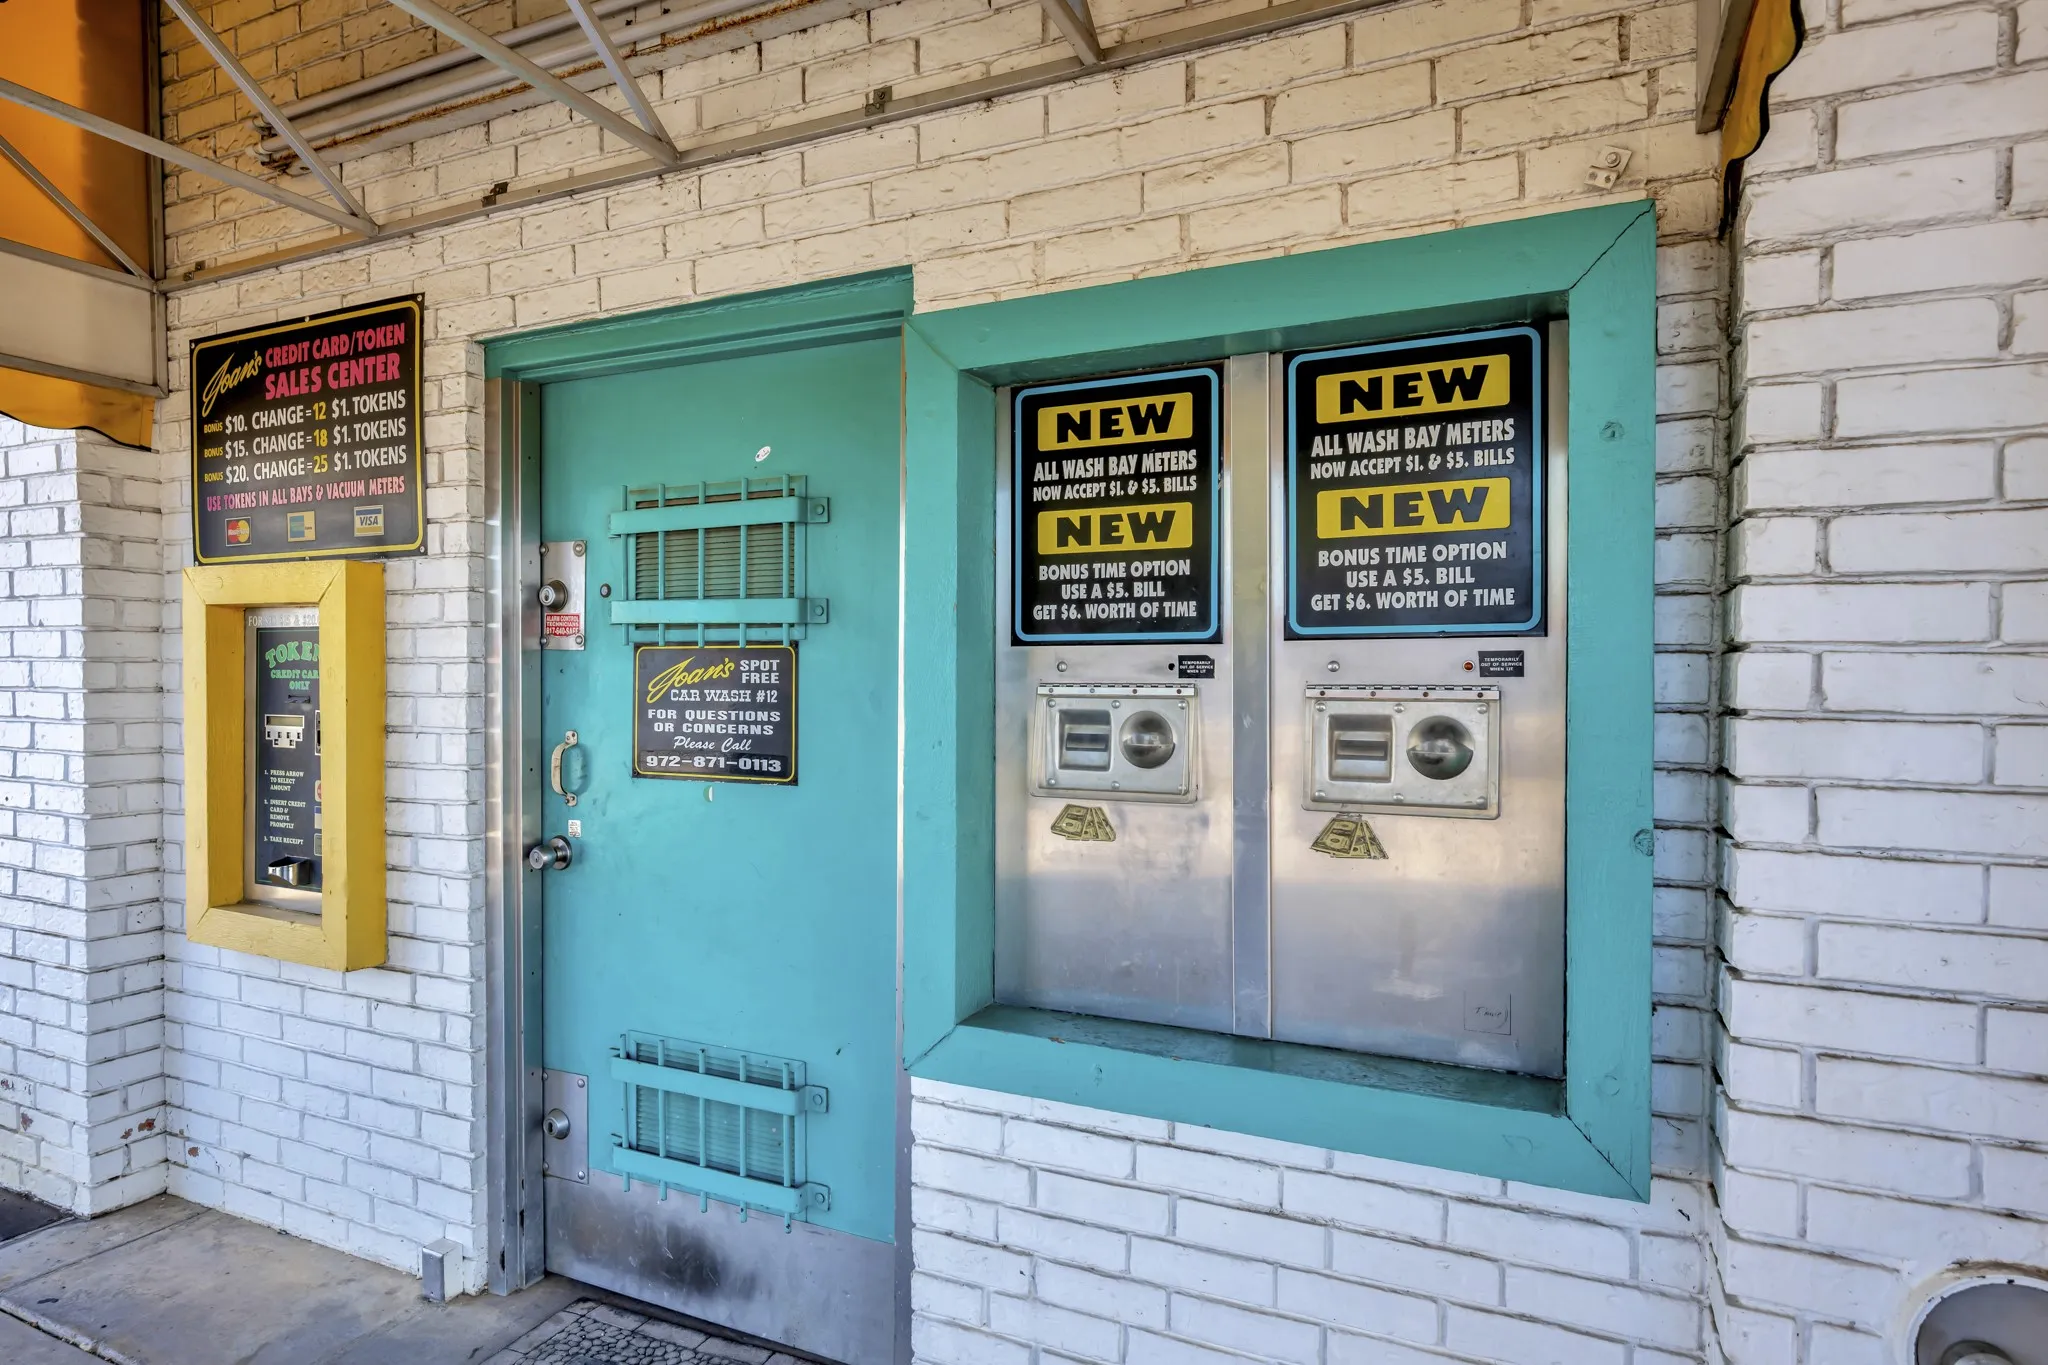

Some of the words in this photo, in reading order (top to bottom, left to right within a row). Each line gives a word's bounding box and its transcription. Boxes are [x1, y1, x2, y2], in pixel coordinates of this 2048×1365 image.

[265, 341, 309, 369] CREDIT
[313, 323, 405, 359] CARD/TOKEN
[202, 351, 262, 417] Joan's
[265, 366, 321, 400] SALES
[327, 353, 400, 390] CENTER
[1340, 364, 1489, 415] NEW
[204, 422, 222, 434] BONUS
[226, 414, 247, 435] $10.
[332, 398, 350, 419] $1.
[353, 390, 406, 415] TOKENS
[1057, 401, 1176, 443] NEW
[204, 447, 223, 458] BONUS
[226, 440, 248, 460] $15.
[334, 425, 351, 445] $1.
[354, 418, 406, 441] TOKENS
[1311, 435, 1342, 457] ALL
[1346, 429, 1398, 453] WASH
[1404, 425, 1441, 449] BAY
[1446, 418, 1514, 445] METERS
[205, 472, 223, 482] BONUS
[226, 466, 249, 485] $20.
[334, 452, 351, 472] $1.
[354, 445, 406, 468] TOKENS
[1034, 461, 1059, 481] ALL
[1063, 457, 1103, 479] WASH
[1109, 454, 1138, 475] BAY
[1142, 450, 1196, 473] METERS
[1310, 461, 1346, 479] NOW
[1349, 457, 1401, 476] ACCEPT
[1428, 453, 1441, 470] &
[1446, 451, 1469, 469] $5.
[1474, 448, 1514, 466] BILLS
[207, 496, 221, 512] USE
[224, 491, 256, 510] TOKENS
[259, 491, 268, 506] IN
[272, 488, 287, 505] ALL
[290, 486, 312, 503] BAYS
[316, 485, 323, 500] &
[327, 479, 365, 499] VACUUM
[369, 476, 405, 495] METERS
[1033, 486, 1061, 501] NOW
[1064, 483, 1105, 499] ACCEPT
[1128, 480, 1138, 495] &
[1142, 478, 1160, 494] $5.
[1163, 476, 1196, 492] BILLS
[360, 516, 378, 526] VISA
[1340, 486, 1490, 531] NEW
[1057, 510, 1176, 548] NEW
[1318, 547, 1380, 567] BONUS
[1385, 545, 1426, 564] TIME
[1432, 542, 1506, 561] OPTION
[1039, 564, 1088, 581] BONUS
[1093, 562, 1126, 578] TIME
[1131, 559, 1190, 577] OPTION
[1346, 570, 1378, 588] USE
[1383, 569, 1397, 586] A
[1403, 568, 1430, 585] $5.
[1436, 566, 1475, 584] BILL
[1061, 584, 1087, 599] USE
[1091, 584, 1102, 599] A
[1107, 582, 1129, 598] $5.
[1134, 581, 1165, 597] BILL
[1311, 594, 1340, 611] GET
[1346, 593, 1370, 610] $6.
[1375, 591, 1438, 609] WORTH
[1444, 590, 1467, 607] OF
[1473, 588, 1515, 606] TIME
[1033, 605, 1057, 620] GET
[1061, 604, 1081, 620] $6.
[1085, 603, 1136, 619] WORTH
[1140, 602, 1160, 617] OF
[1163, 601, 1196, 617] TIME
[271, 670, 300, 678] CREDIT
[740, 659, 780, 671] SPOT
[289, 681, 310, 690] ONLY
[647, 656, 735, 703] Joan's
[742, 673, 779, 683] FREE
[671, 689, 700, 701] CAR
[704, 690, 751, 702] WASH
[756, 690, 777, 703] #12
[648, 709, 677, 719] FOR
[685, 710, 780, 721] QUESTIONS
[654, 723, 674, 732] OR
[683, 723, 773, 735] CONCERNS
[673, 736, 715, 750] Please
[721, 738, 752, 752] Call
[646, 755, 781, 772] 972-871-0113
